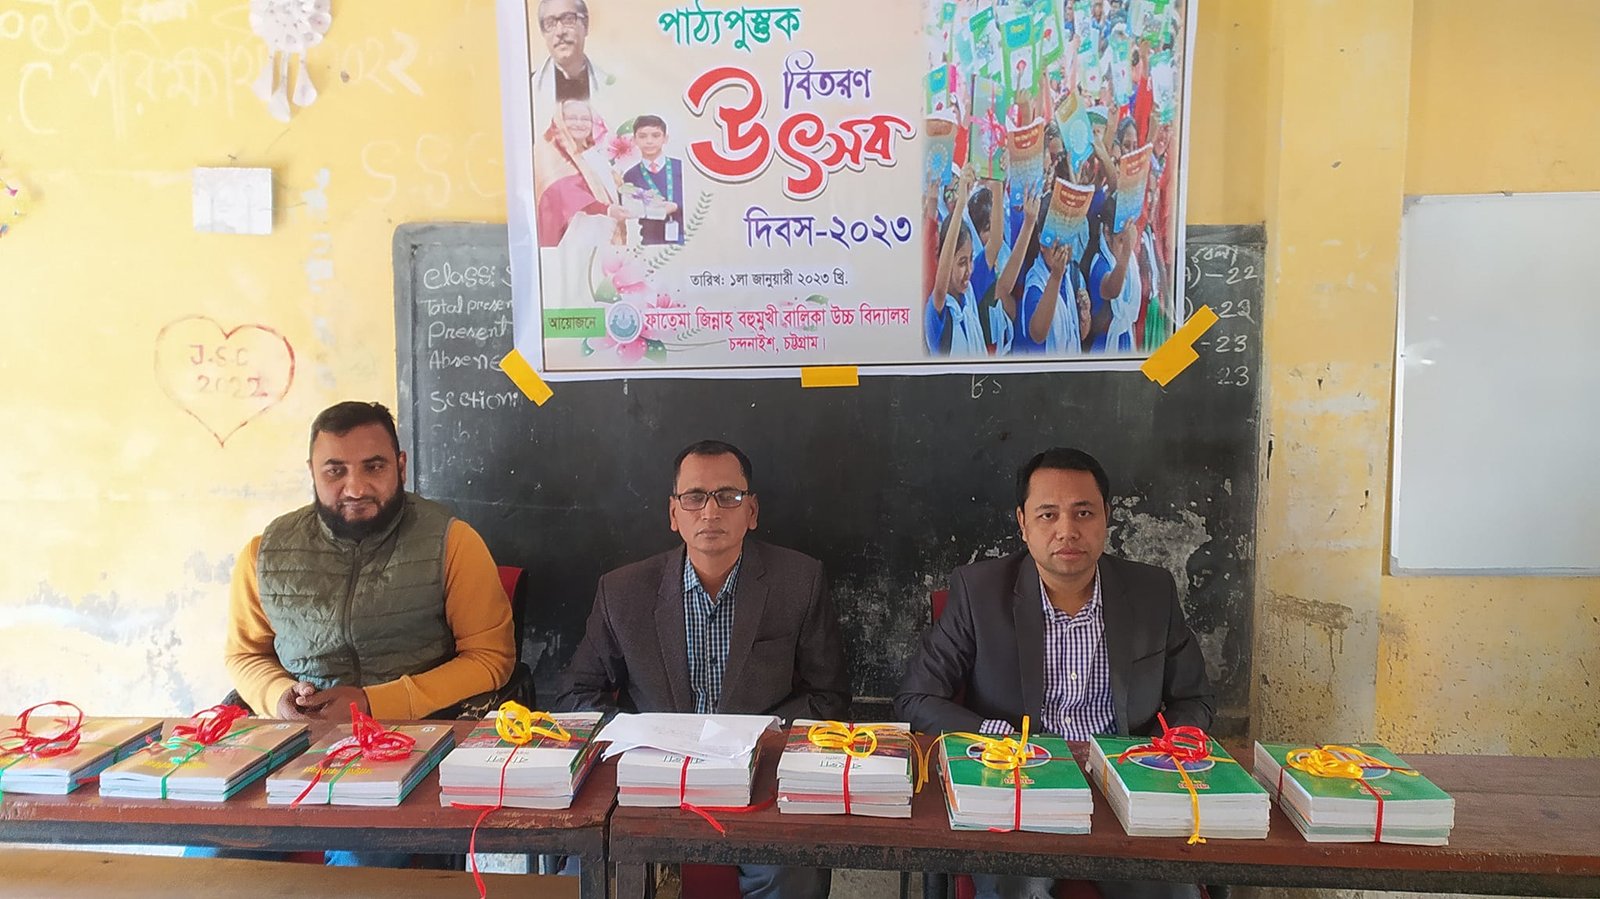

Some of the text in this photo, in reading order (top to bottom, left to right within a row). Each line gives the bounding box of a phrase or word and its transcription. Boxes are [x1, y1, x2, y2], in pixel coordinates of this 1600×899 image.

[783, 51, 872, 109] বিতরণ
[685, 66, 914, 197] উৎসব
[744, 206, 912, 249] দিবস-২০২৩
[690, 271, 725, 287] তারিখ:
[730, 273, 748, 287] ১লা
[752, 269, 793, 288] জানুয়ারী
[797, 271, 830, 287] ২০২৩
[418, 295, 463, 317] Total
[644, 311, 691, 332] ফাতেমা
[737, 304, 778, 332] বহুমুখী
[783, 304, 826, 328] বালিকা
[830, 304, 855, 325] উচ্চ
[860, 303, 910, 326] বিদ্যালয়
[549, 316, 597, 331] আয়োজনে
